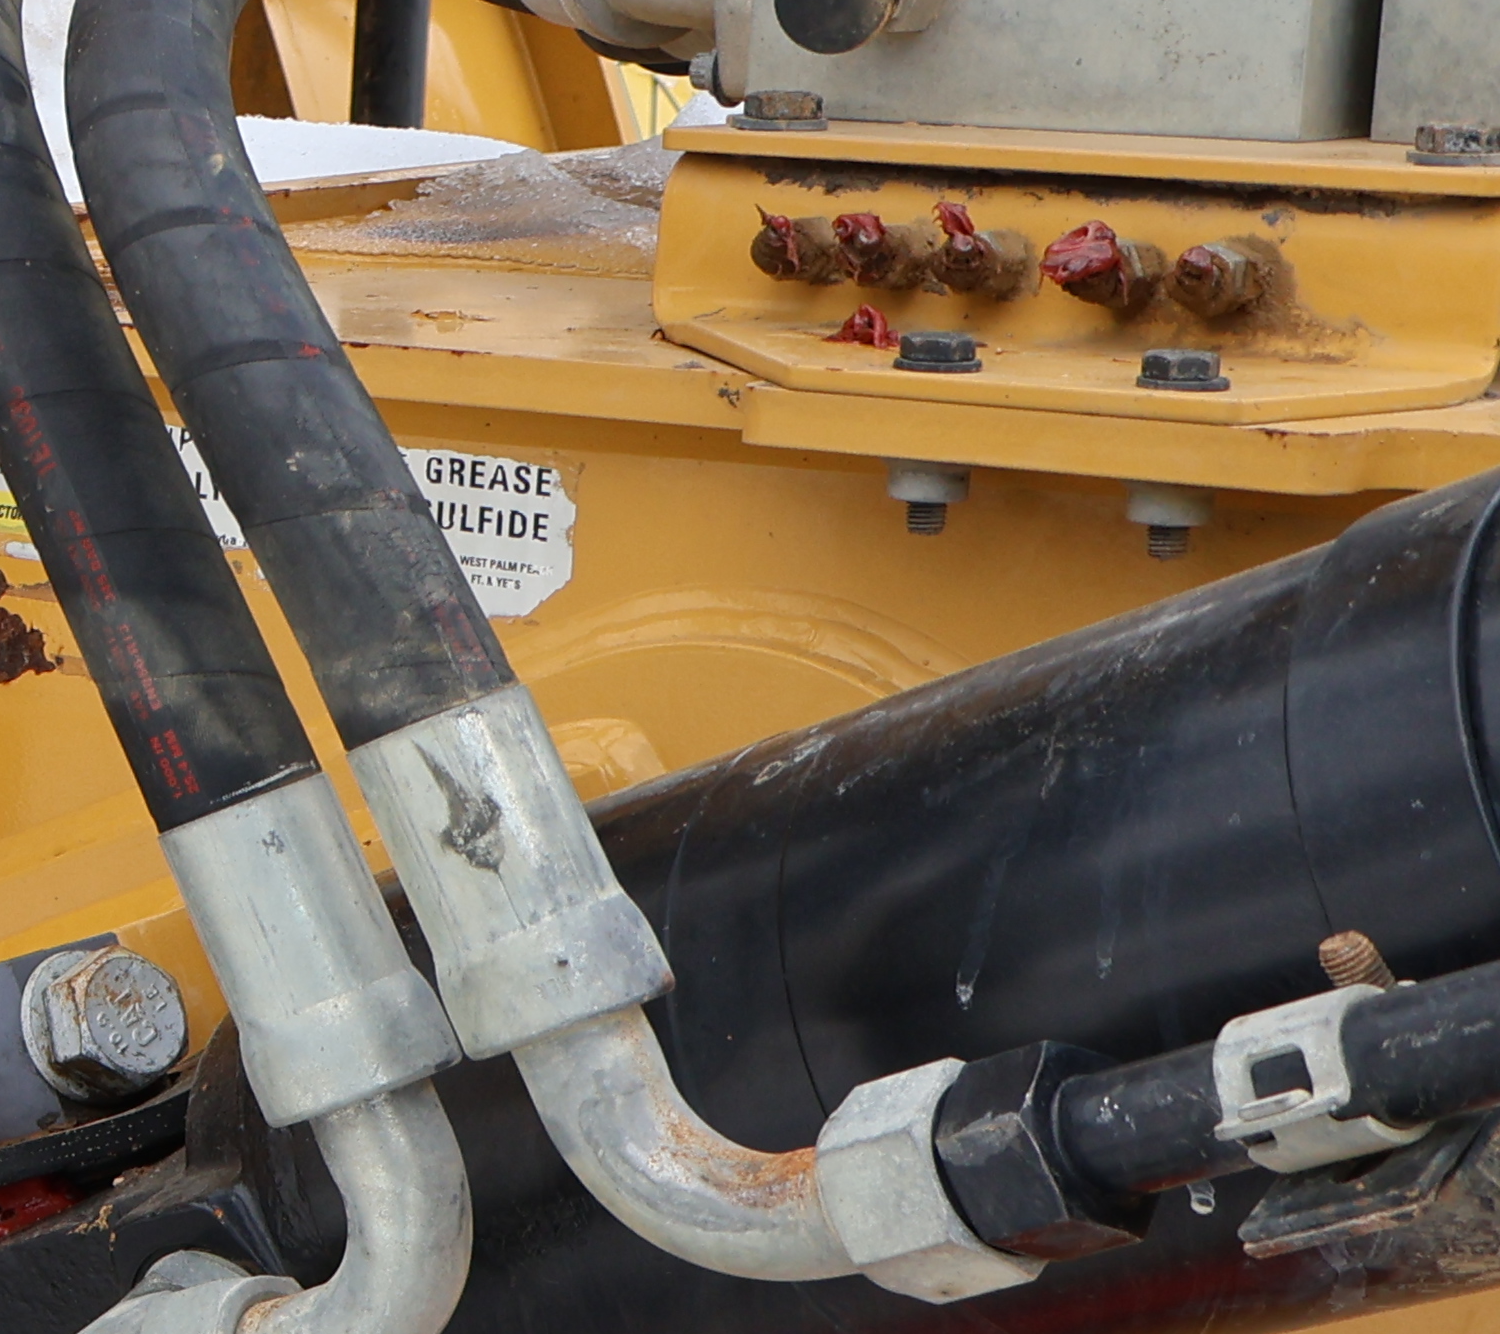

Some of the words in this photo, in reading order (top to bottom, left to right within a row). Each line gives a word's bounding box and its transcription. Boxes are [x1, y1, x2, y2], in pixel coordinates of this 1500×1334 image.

[426, 457, 553, 497] GREASE
[424, 498, 550, 542] ULFIDE
[460, 555, 488, 568] WEST
[489, 559, 518, 572] PALM
[471, 573, 485, 586] FT.
[163, 727, 184, 758] MM
